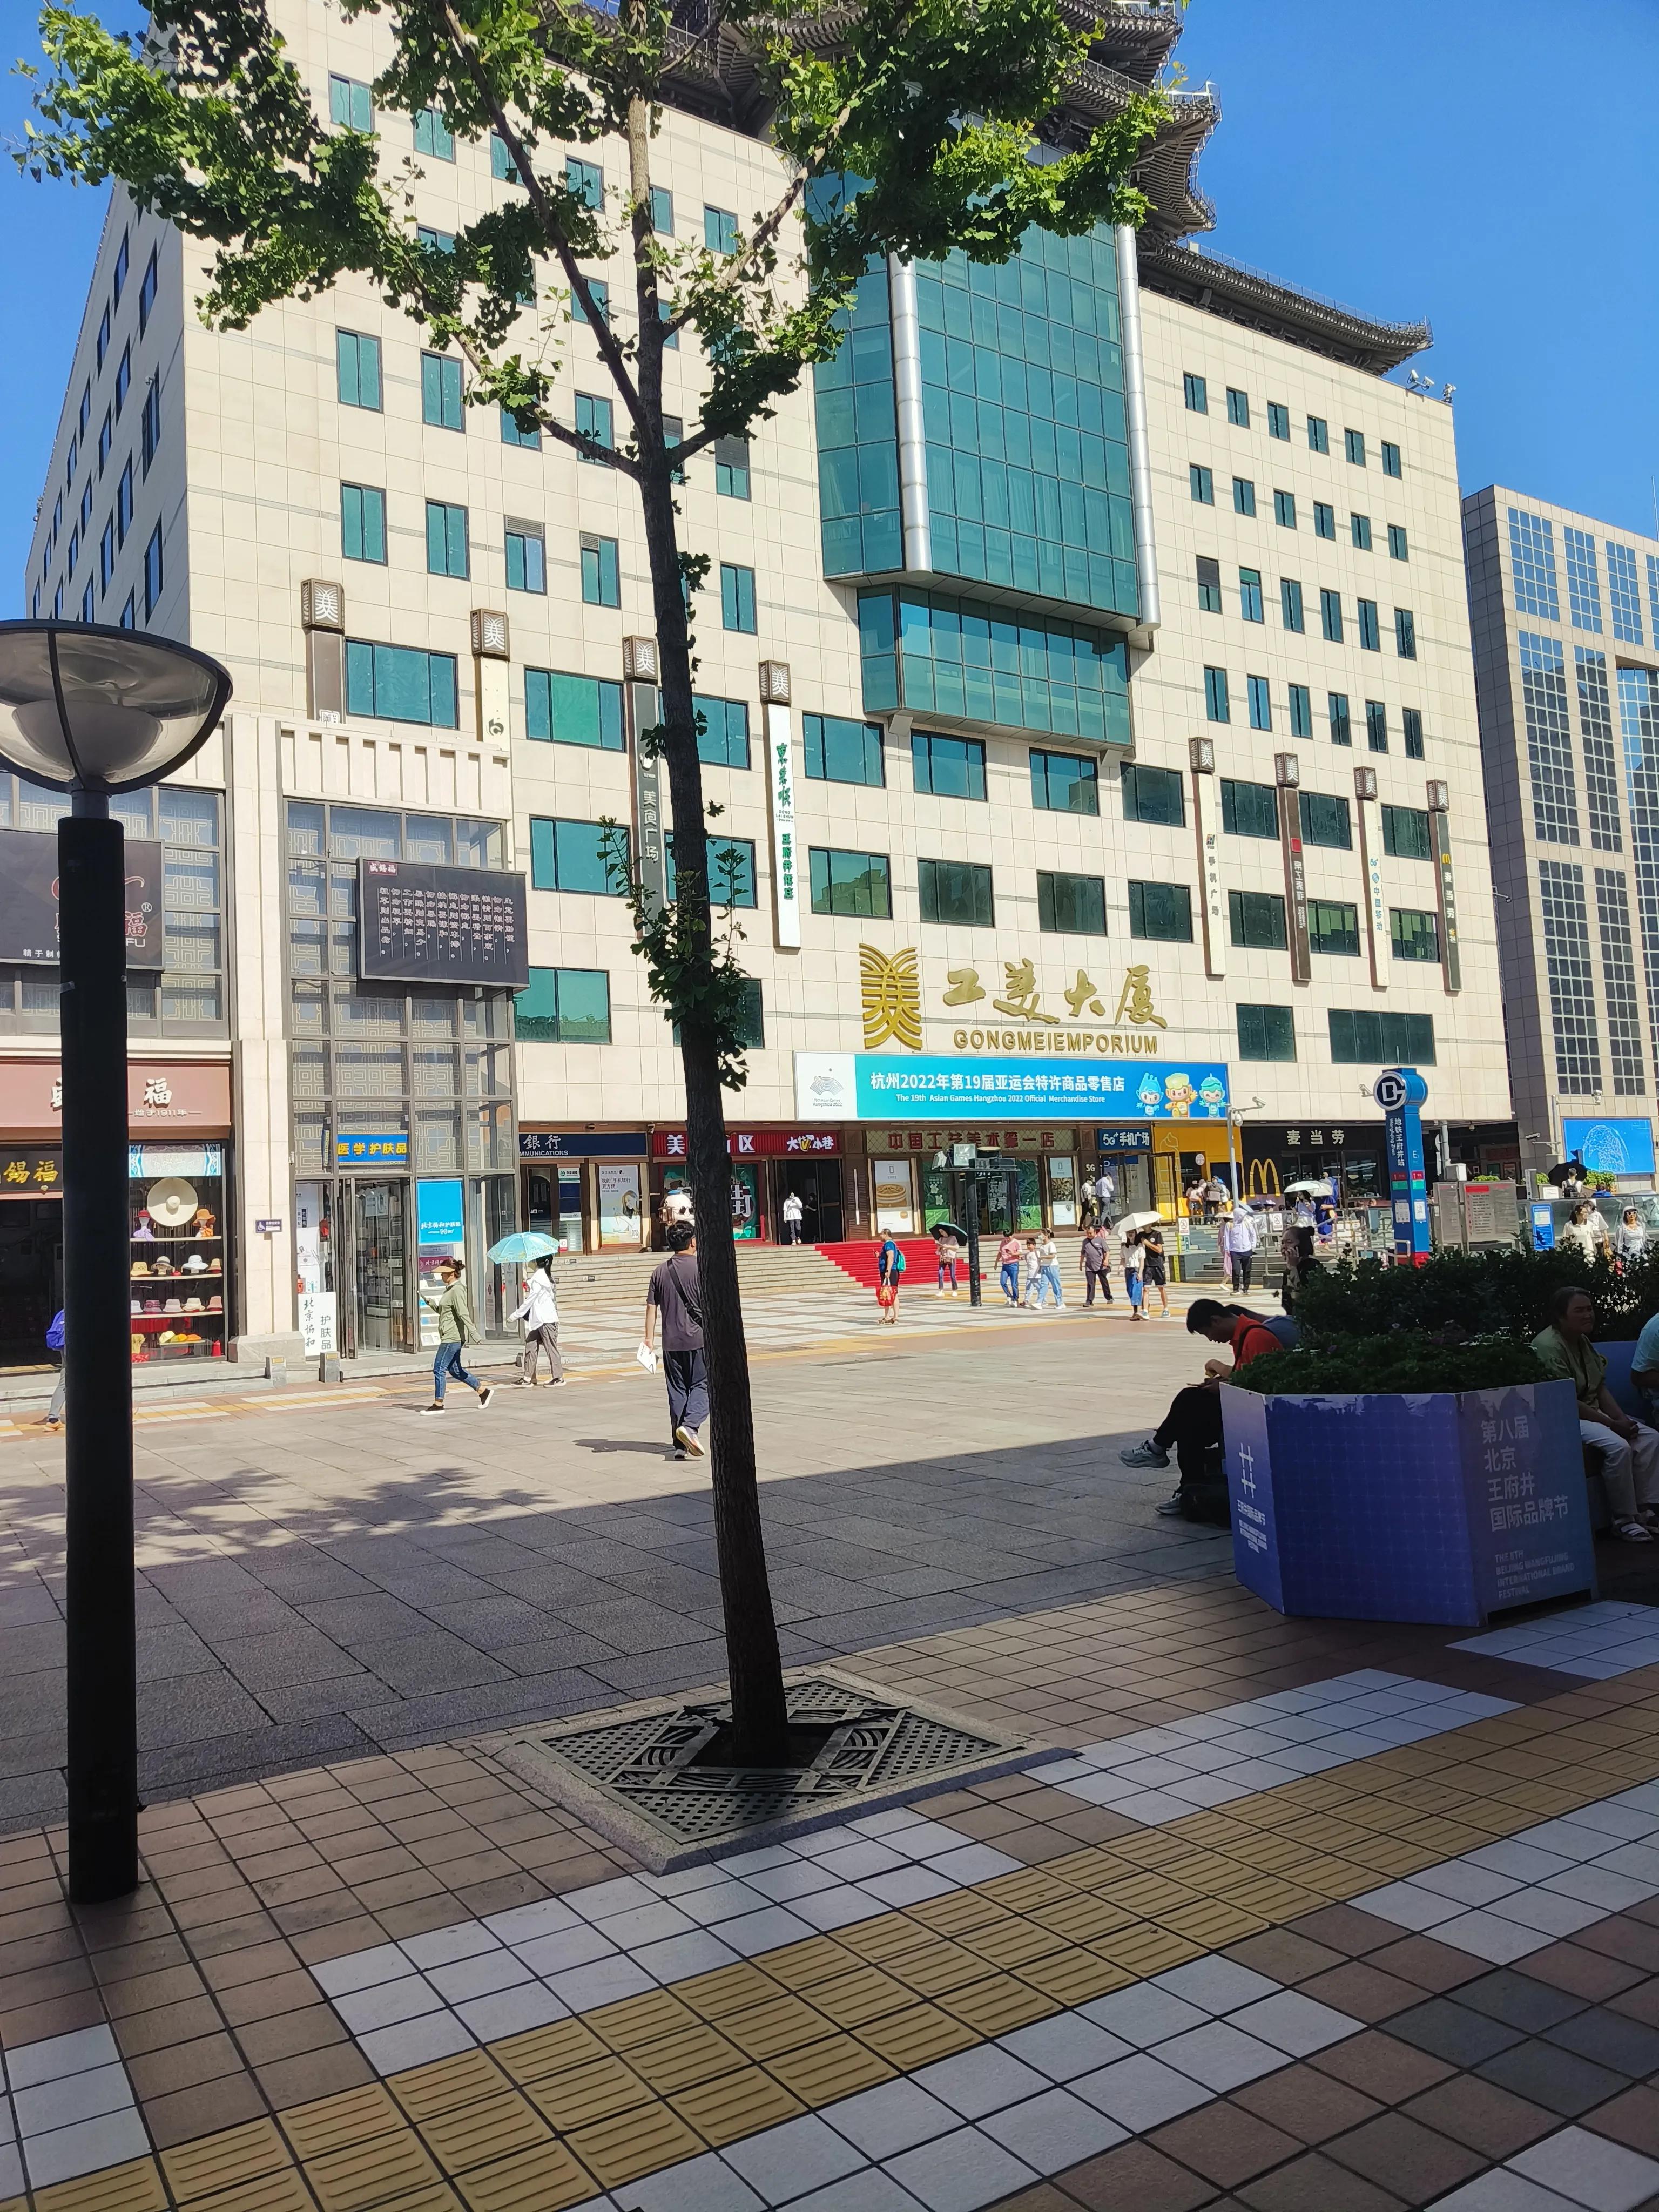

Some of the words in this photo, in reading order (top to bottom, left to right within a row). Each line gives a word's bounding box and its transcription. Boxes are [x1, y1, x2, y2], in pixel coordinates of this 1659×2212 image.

[643, 790, 658, 863] 美食广场
[1373, 885, 1383, 931] 中国移动
[1444, 872, 1454, 919] 麦当劳
[942, 957, 1168, 1029] 工美大厦
[870, 1071, 1125, 1092] 杭州2022年第19届亚运会特许商品零售店
[896, 1094, 909, 1102] The
[911, 1094, 927, 1102] 19th
[929, 1094, 948, 1102] Asian
[974, 1095, 1007, 1104] Hangzhou
[1024, 1094, 1046, 1103] Official
[134, 1109, 187, 1117] 始于1911年
[338, 1142, 407, 1156] 医学护肤品
[1120, 1131, 1150, 1147] 手机广场
[1287, 1129, 1344, 1145] 麦当劳
[1395, 1117, 1405, 1166] 地铁王府井站
[0, 1159, 58, 1184] 锡福
[1085, 1164, 1095, 1172] 5G
[320, 1314, 332, 1350] 护肤品
[1480, 1415, 1529, 1444] 第八届
[1484, 1446, 1517, 1473] 北京
[1487, 1471, 1535, 1502] 王府井
[1489, 1494, 1568, 1532] 国际品牌节
[1495, 1553, 1509, 1563] THE
[1498, 1584, 1530, 1600] FESTIVAL
